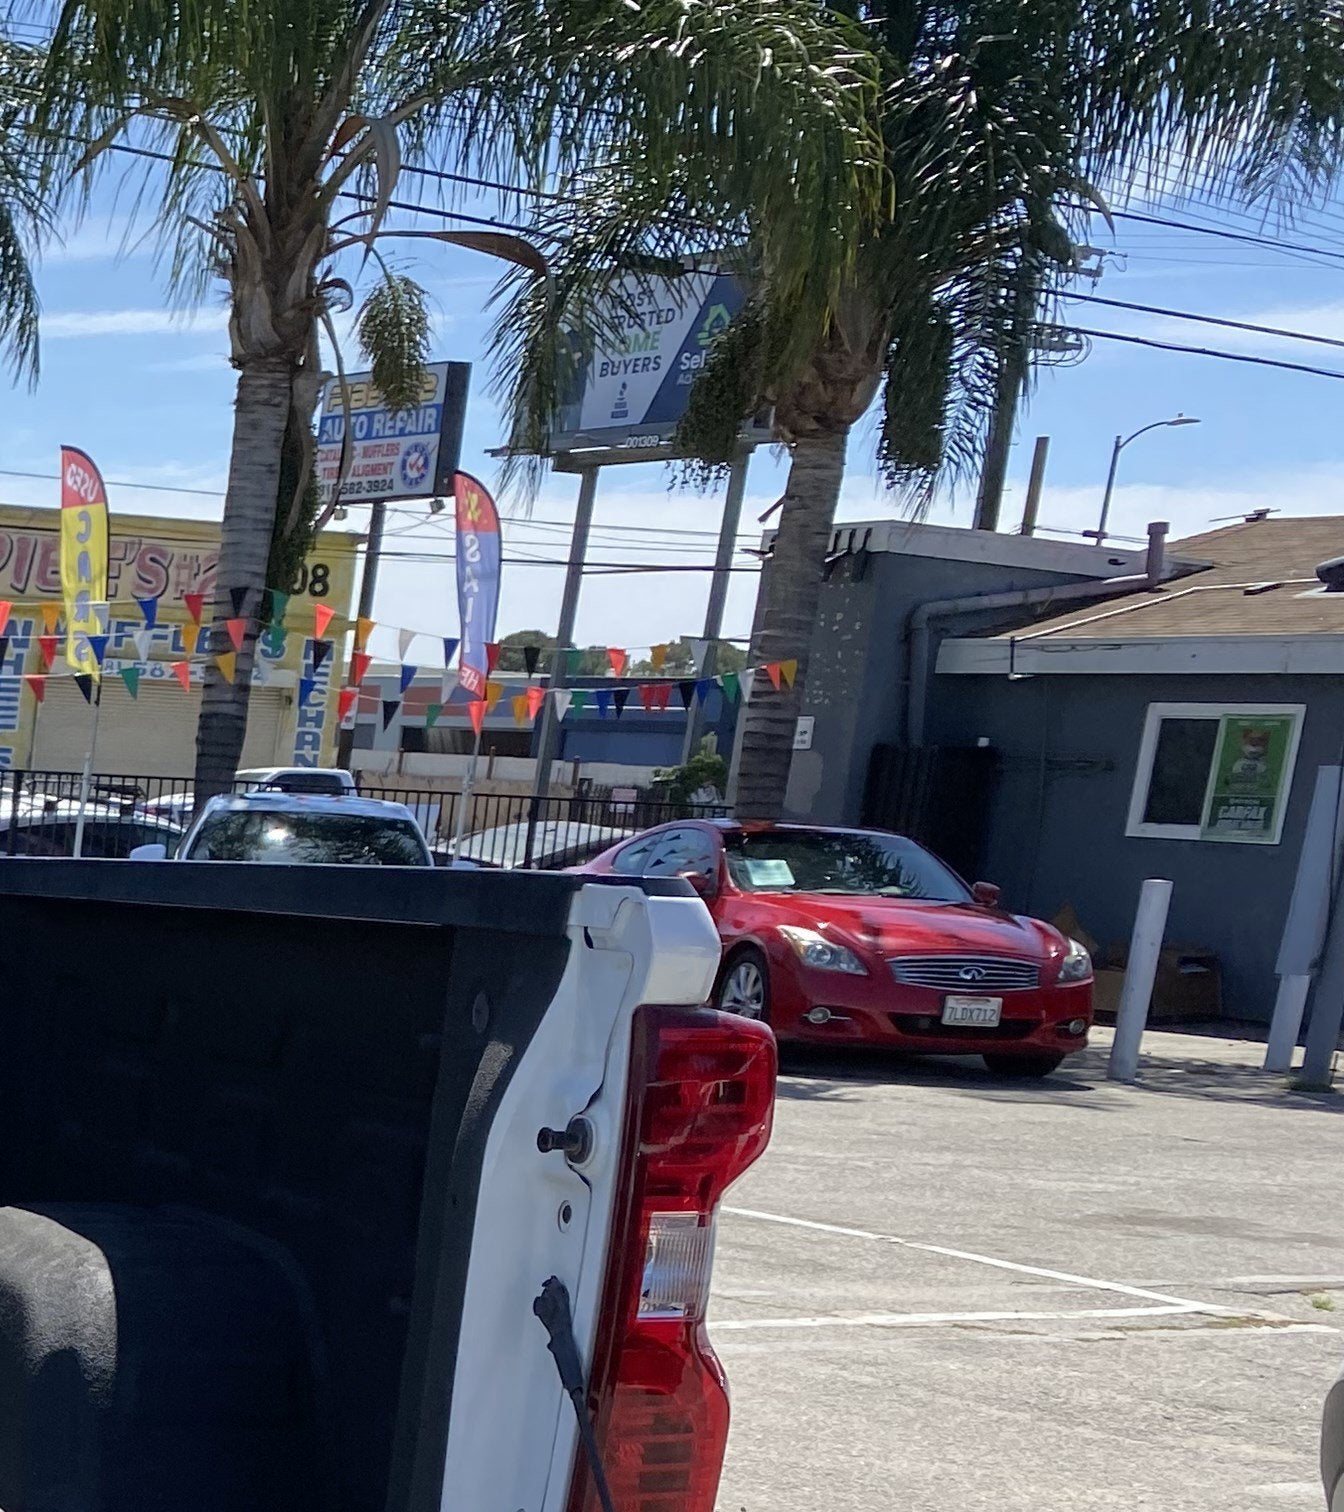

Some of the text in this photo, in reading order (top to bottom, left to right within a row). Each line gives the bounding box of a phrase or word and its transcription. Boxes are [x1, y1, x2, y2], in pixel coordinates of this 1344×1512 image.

[610, 330, 662, 355] OME
[600, 355, 662, 378] BUYERS
[679, 349, 706, 371] Sel
[321, 406, 438, 443] AUO REPAIR
[947, 1006, 997, 1023] 7LDX712
